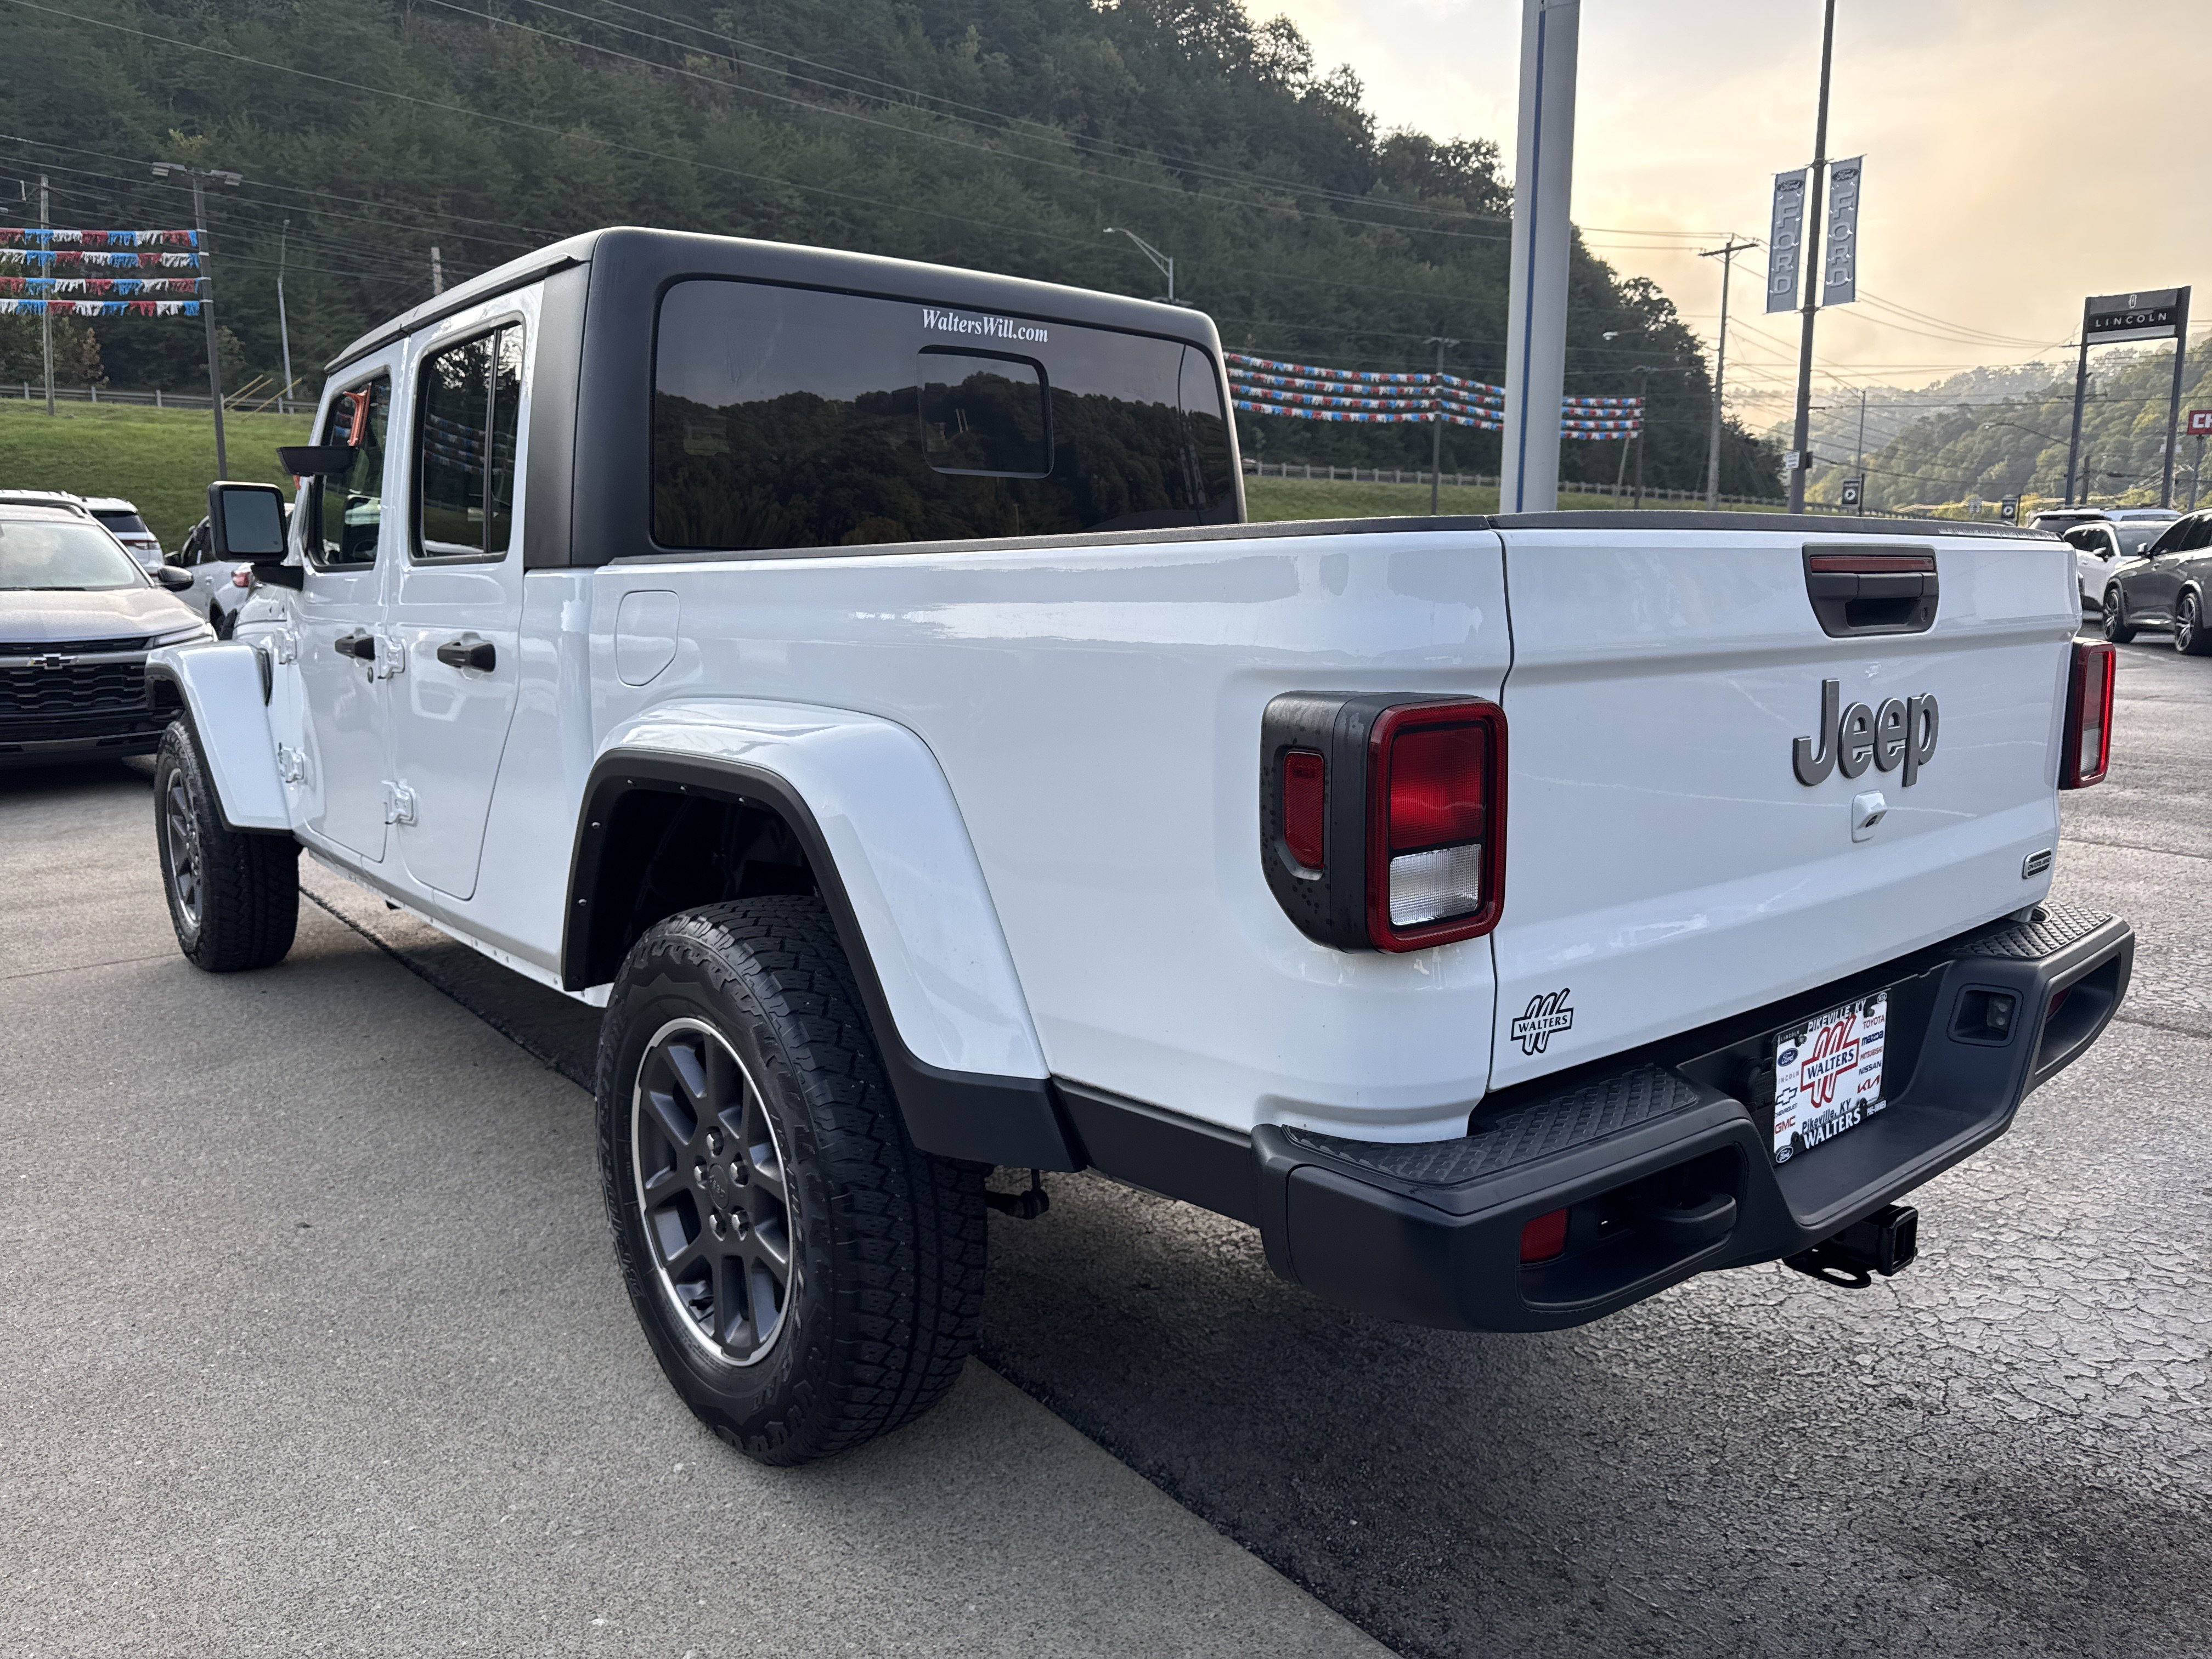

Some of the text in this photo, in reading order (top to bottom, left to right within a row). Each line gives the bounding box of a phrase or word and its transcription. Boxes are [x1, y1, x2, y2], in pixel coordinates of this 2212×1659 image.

[1771, 202, 1799, 296] FORD
[1830, 190, 1855, 288] FORD
[922, 309, 1048, 342] WaltersWill.com
[2095, 312, 2167, 328] LINCOLN
[1792, 678, 1939, 787] Jeep
[2028, 857, 2051, 870] OVERLAND
[1518, 1014, 1568, 1033] WALTERS
[1807, 999, 1867, 1034] PIKEVILLE, KY
[1863, 1014, 1885, 1030] TOYOTA
[1780, 1030, 1800, 1042] LINCOLN
[1860, 1046, 1883, 1061] MITSUBISHI
[1807, 1048, 1854, 1080] WALTERS
[1858, 1060, 1882, 1076] NISSAN
[1778, 1070, 1800, 1085] INCOLN
[1775, 1115, 1796, 1135] GMC
[1802, 1098, 1852, 1134] Pikeville, KY
[1803, 1108, 1861, 1149] WALTERS
